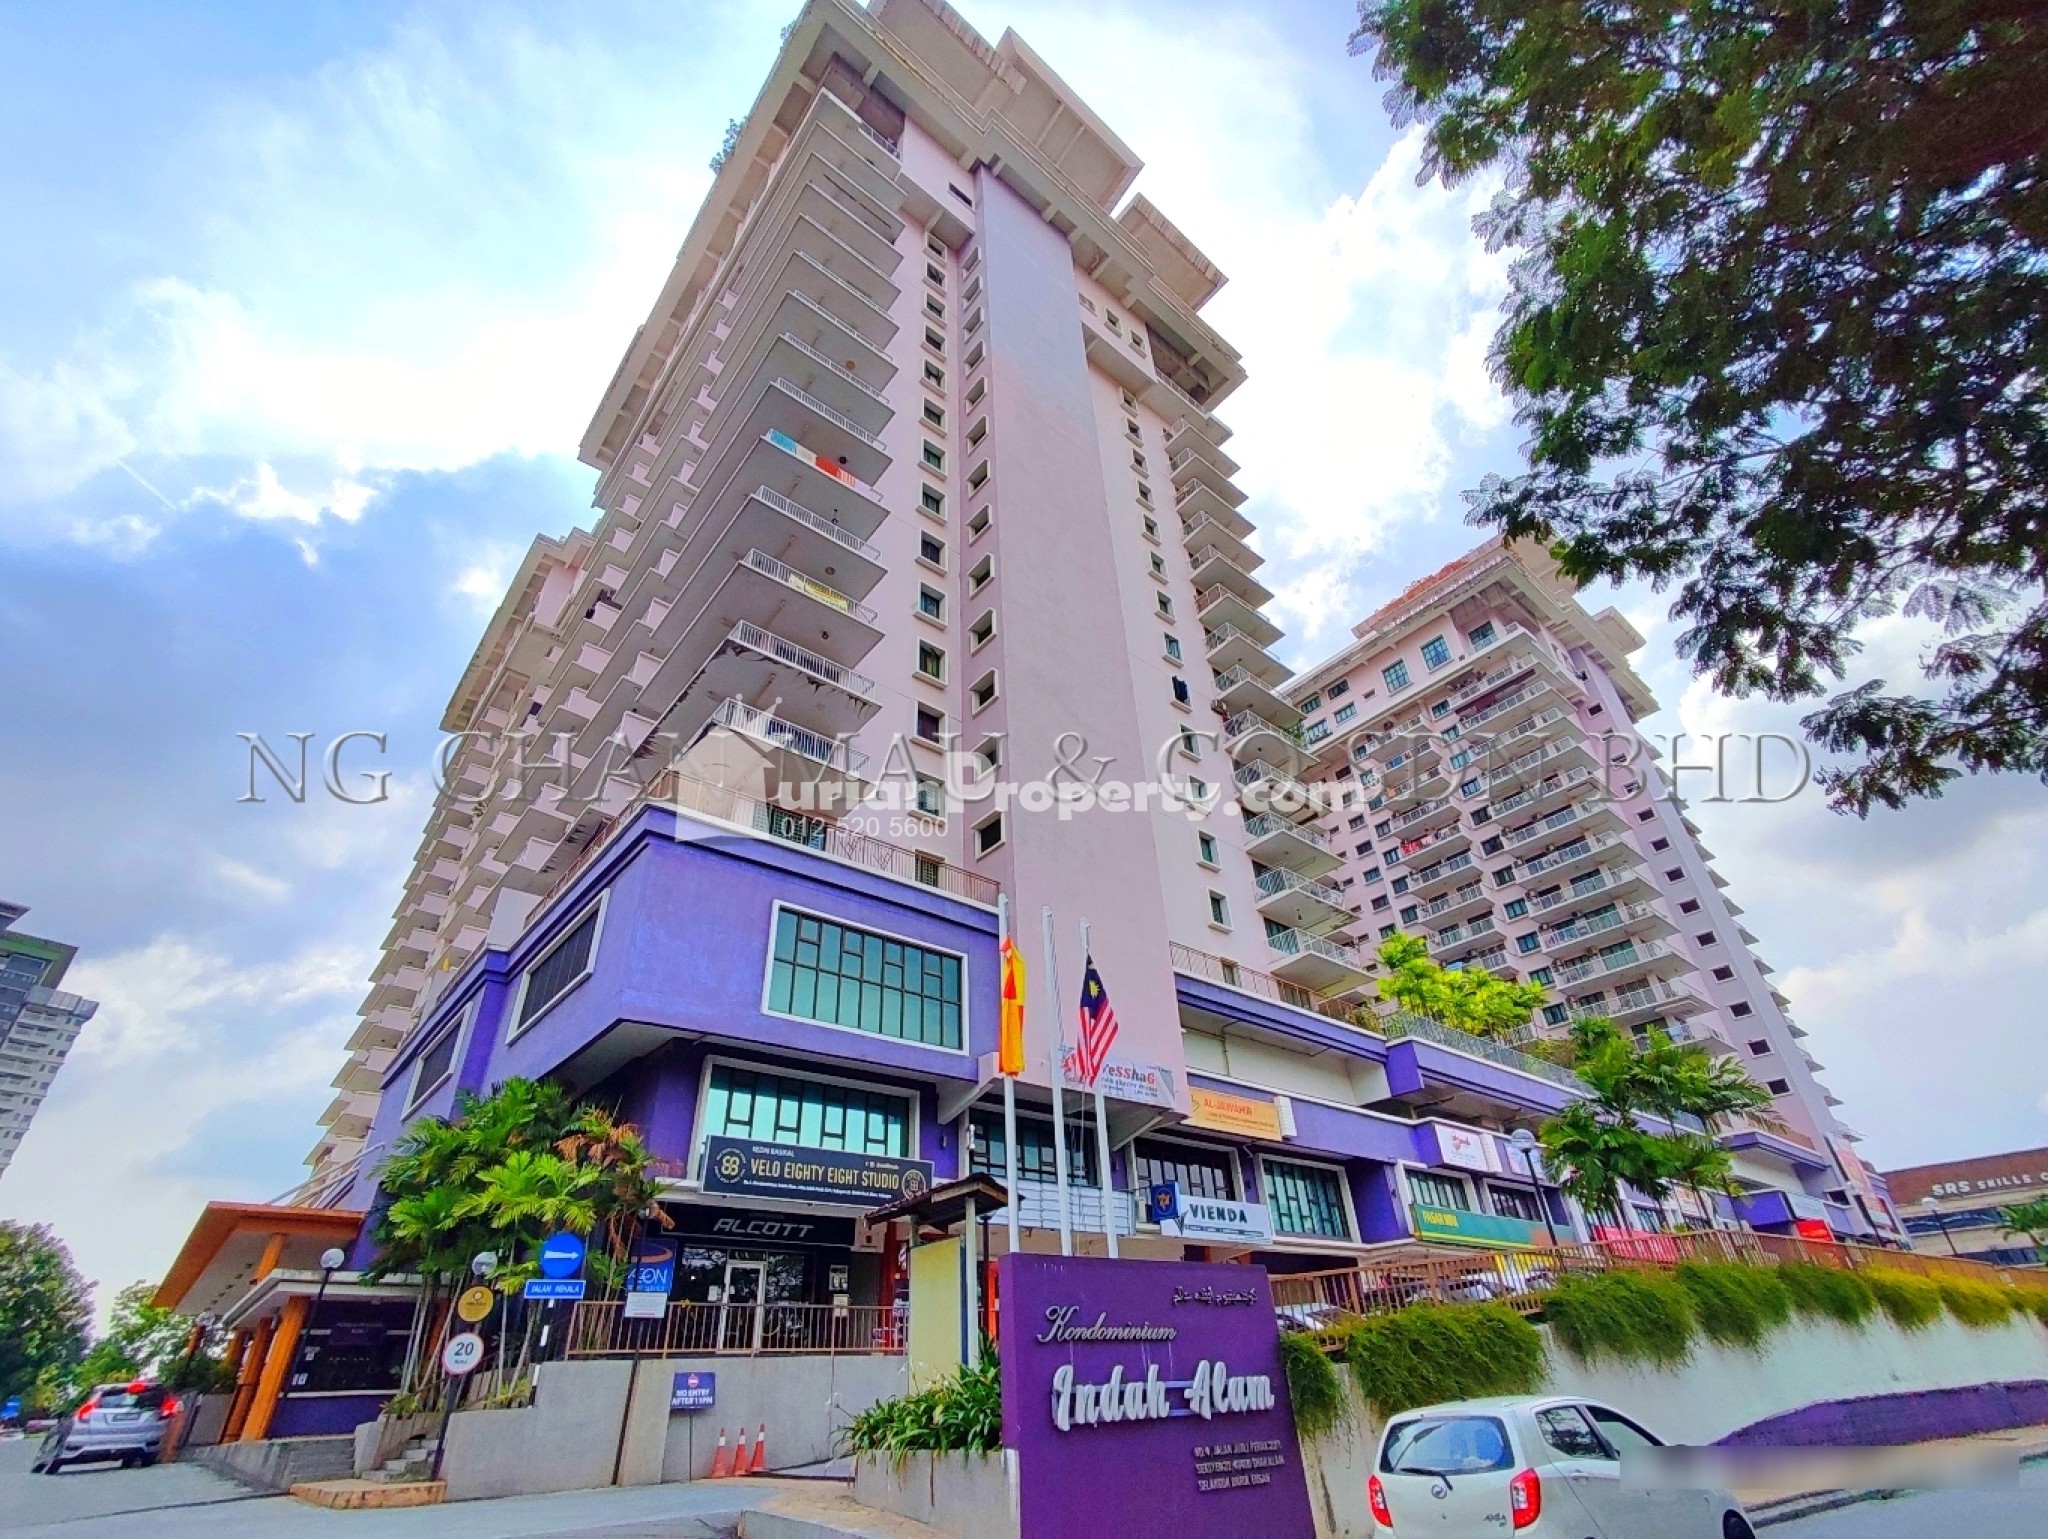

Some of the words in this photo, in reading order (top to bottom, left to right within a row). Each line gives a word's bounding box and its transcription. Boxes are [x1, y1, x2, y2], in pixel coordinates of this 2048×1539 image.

[750, 1157, 780, 1178] VELO
[784, 1161, 826, 1183] EIGHTY
[827, 1166, 859, 1184] EIGHT
[861, 1170, 900, 1190] STUDIO
[1931, 1180, 1971, 1197] SRS
[1976, 1173, 2032, 1190] SKILLS
[1189, 1203, 1248, 1224] VIENDA
[713, 1218, 815, 1238] ALCOTT
[1037, 1305, 1177, 1344] Kondominium
[453, 1341, 474, 1357] 20
[1053, 1362, 1170, 1432] Indah
[1184, 1359, 1275, 1421] Alam
